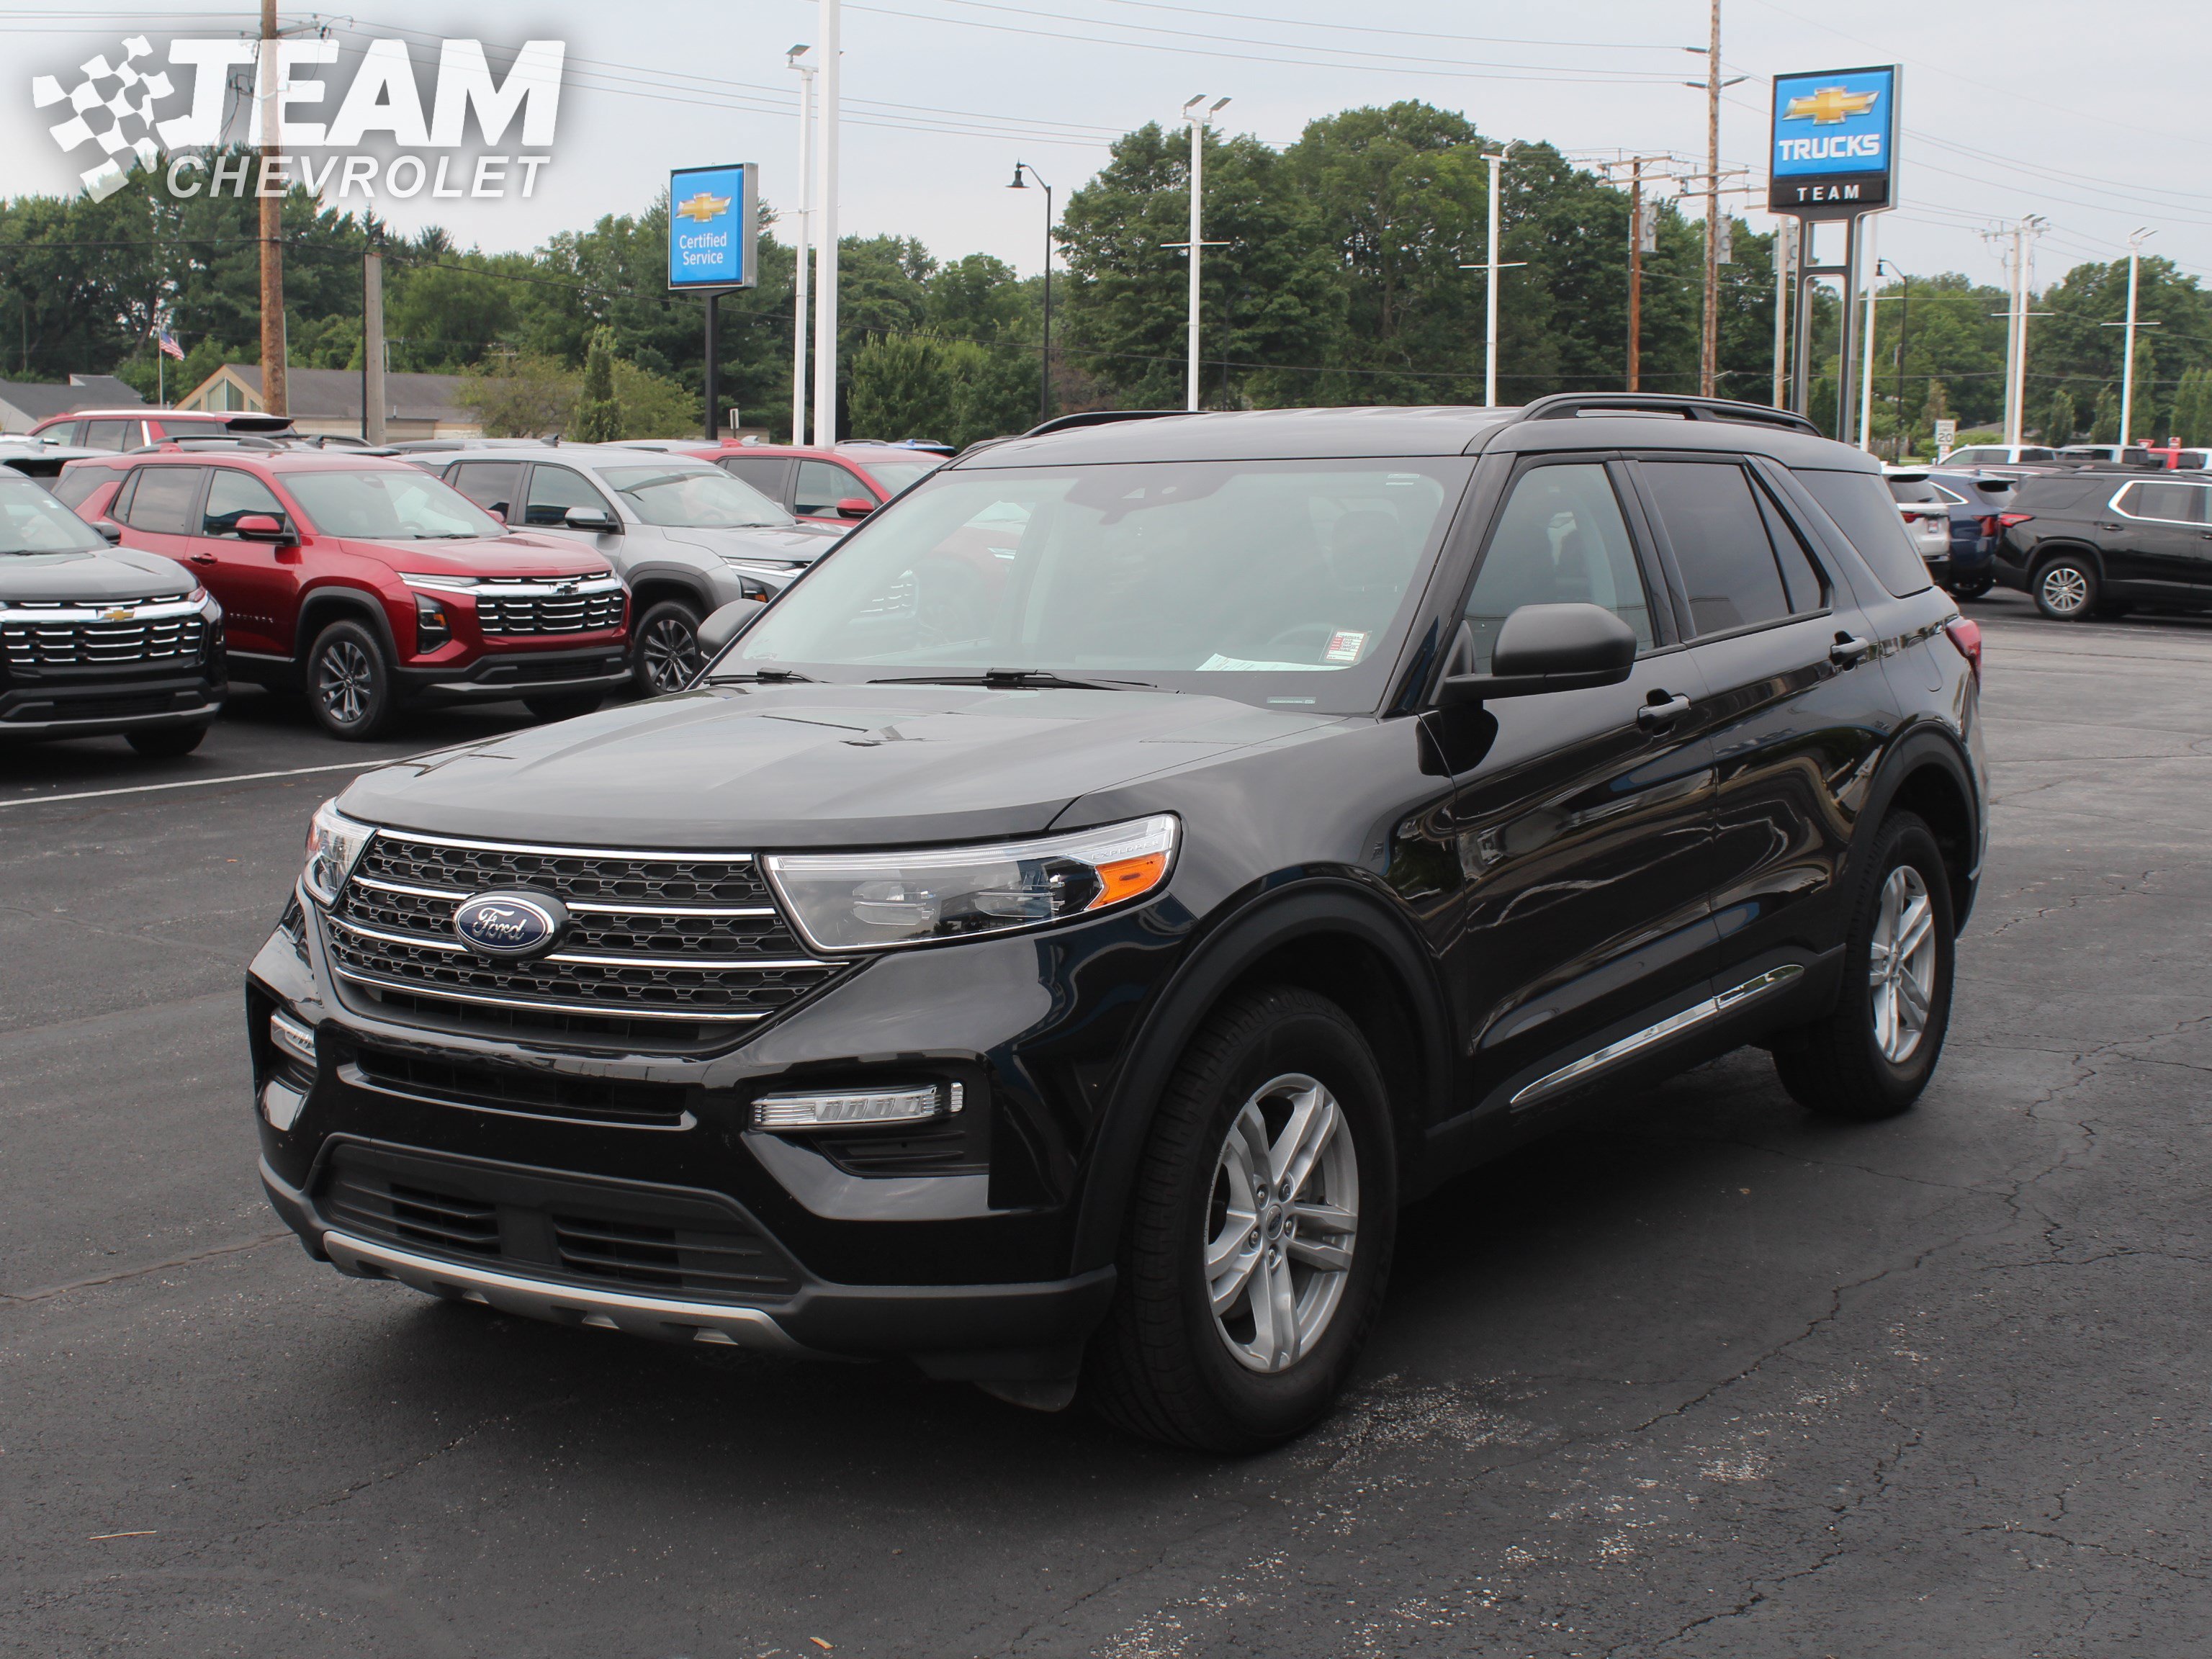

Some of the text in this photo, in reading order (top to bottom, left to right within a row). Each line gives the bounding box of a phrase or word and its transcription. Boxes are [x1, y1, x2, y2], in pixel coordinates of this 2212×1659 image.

[1779, 134, 1881, 161] TRUCKS
[1797, 184, 1860, 202] TEAM
[679, 231, 727, 249] Certified
[683, 250, 723, 266] Service
[1938, 433, 1954, 442] 20
[1092, 840, 1159, 860] EXPLORER
[472, 907, 527, 942] Ford
